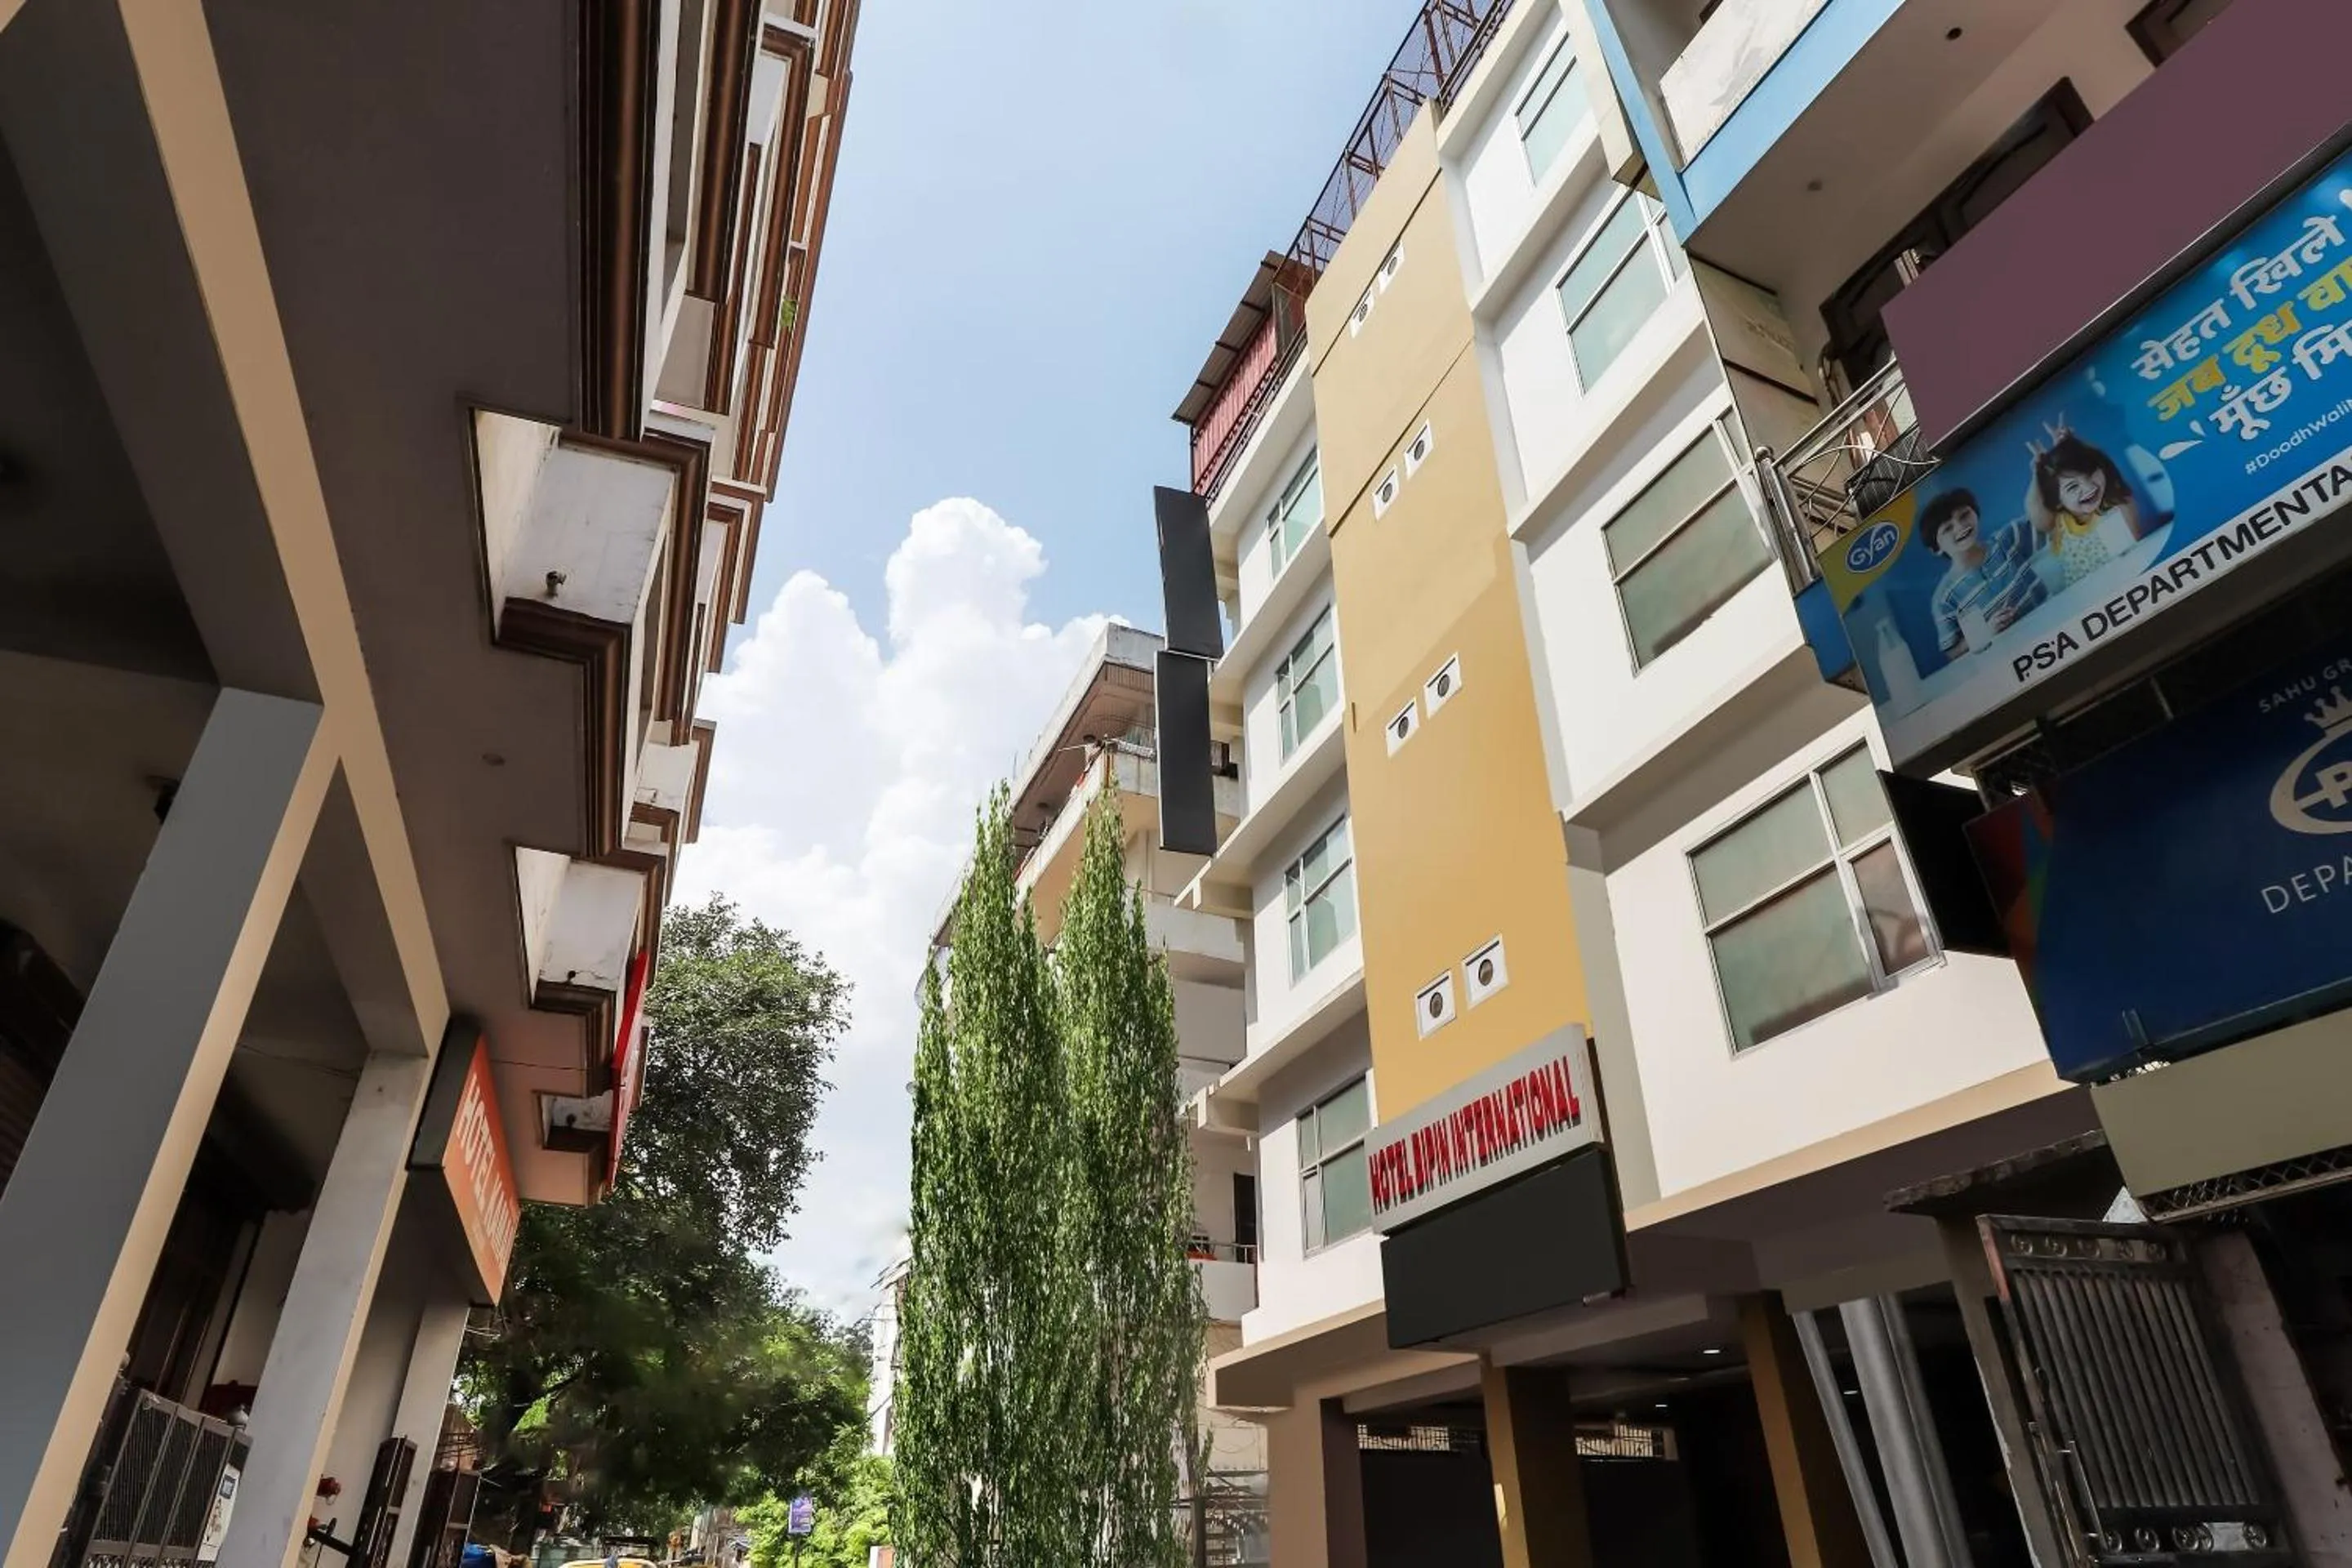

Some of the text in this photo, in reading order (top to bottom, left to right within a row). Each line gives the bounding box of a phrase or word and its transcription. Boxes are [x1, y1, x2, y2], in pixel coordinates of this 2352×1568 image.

[2131, 215, 2346, 380] सेहत खिले
[2147, 354, 2227, 421] जब
[2222, 301, 2303, 373] दूध
[1850, 523, 1896, 566] Gyan
[2012, 464, 2352, 683] PSA DEPARTMENTA
[2258, 675, 2317, 714] SAHU
[456, 1072, 497, 1217] HOTEL
[1369, 1138, 1415, 1216] HOTEL
[1450, 1055, 1582, 1179] INTERNATIONAL
